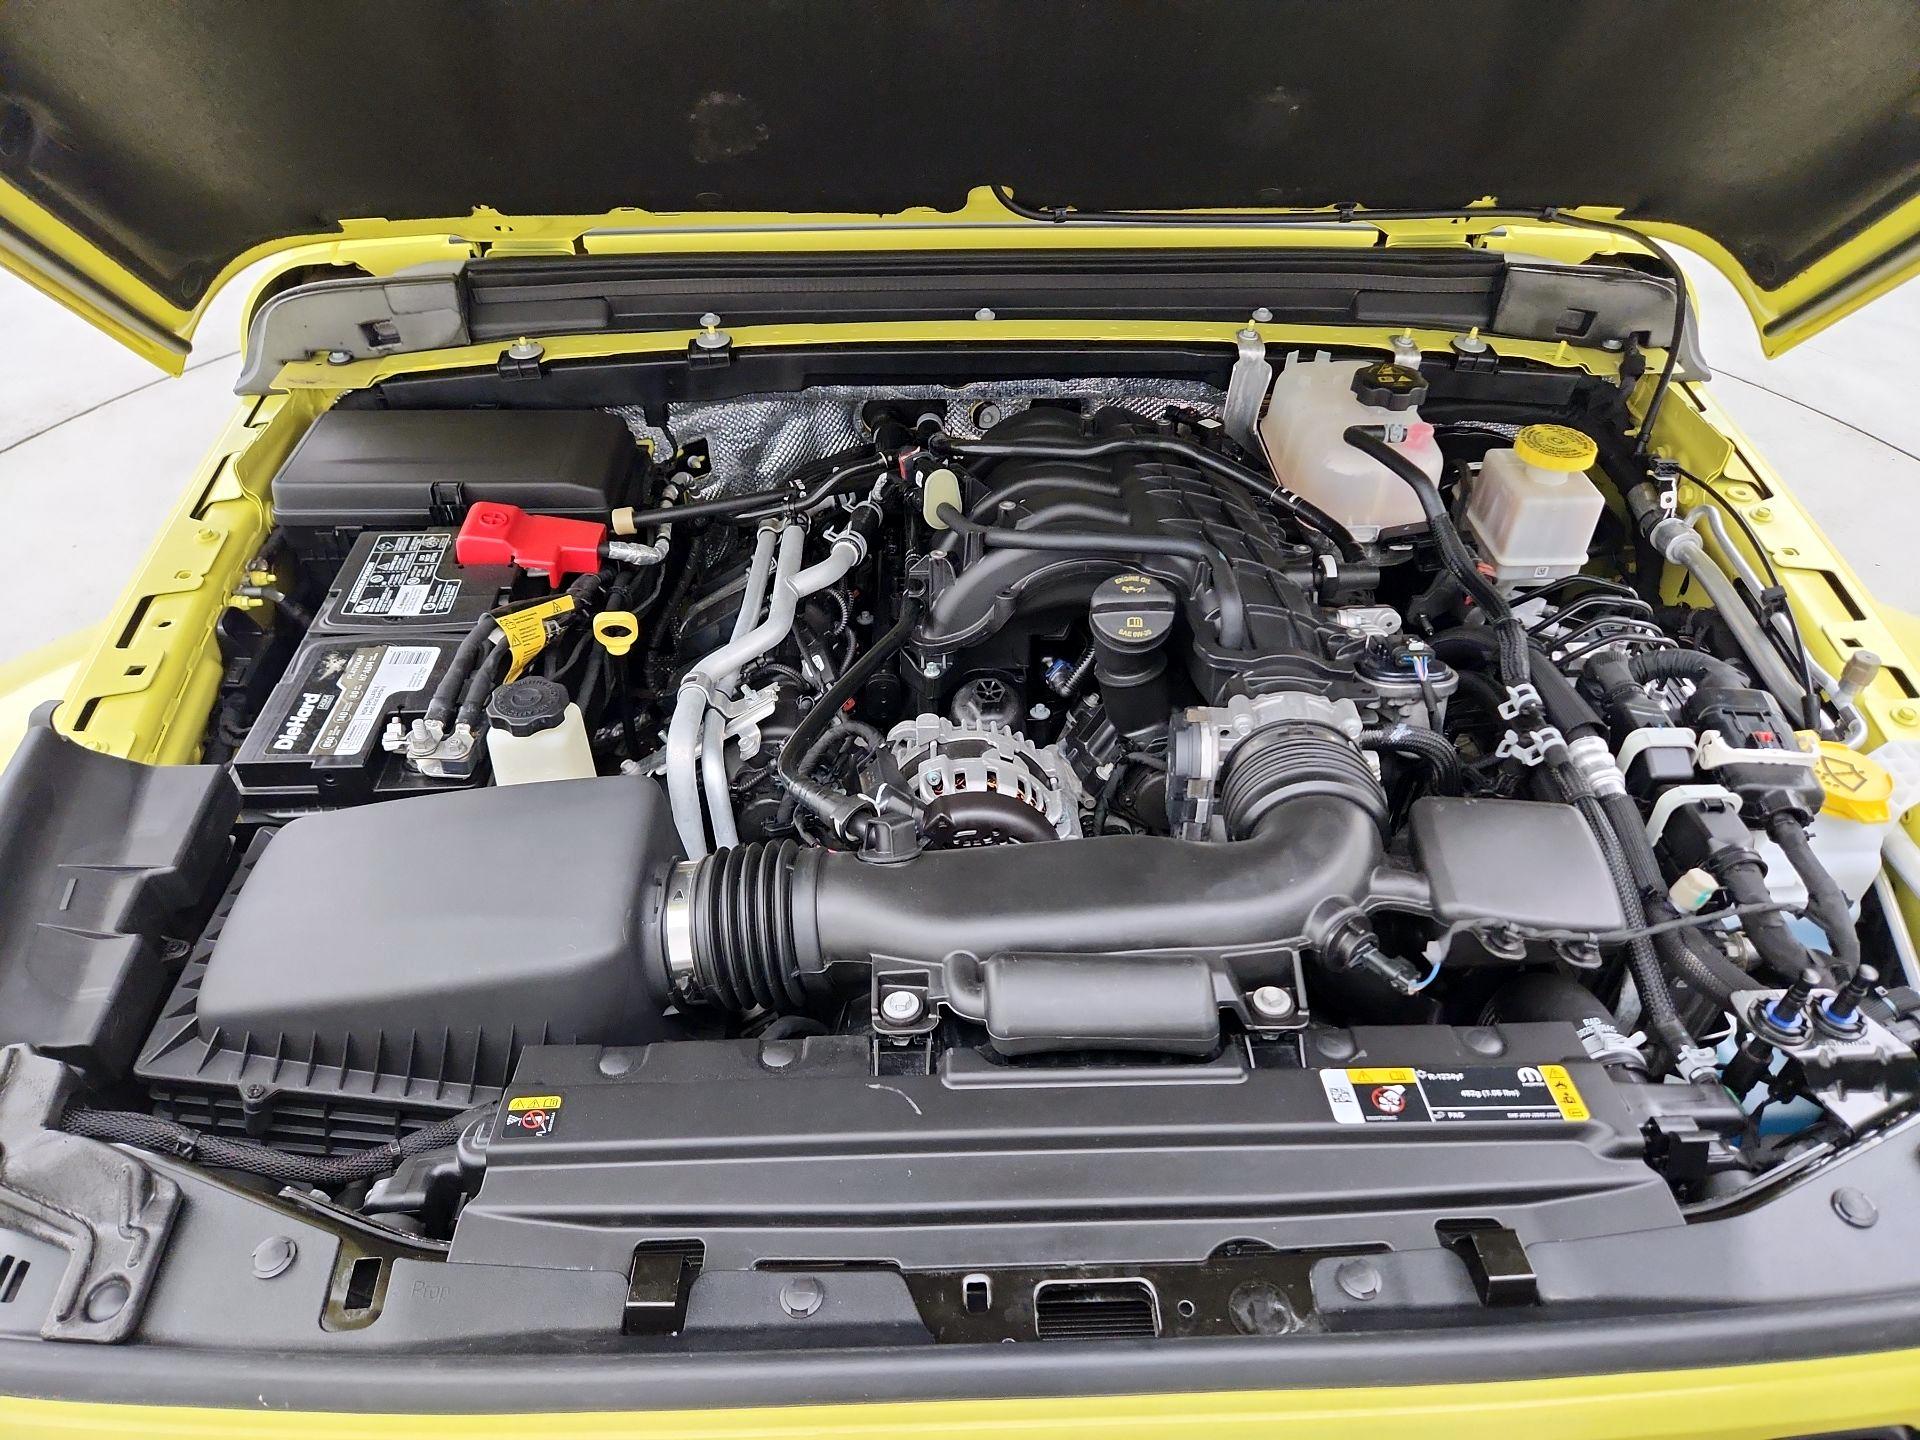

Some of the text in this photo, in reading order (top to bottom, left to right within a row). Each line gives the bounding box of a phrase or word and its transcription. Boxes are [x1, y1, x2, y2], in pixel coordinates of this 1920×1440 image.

[1114, 575, 1151, 585] ENGINE OIL
[273, 692, 322, 750] DieHard
